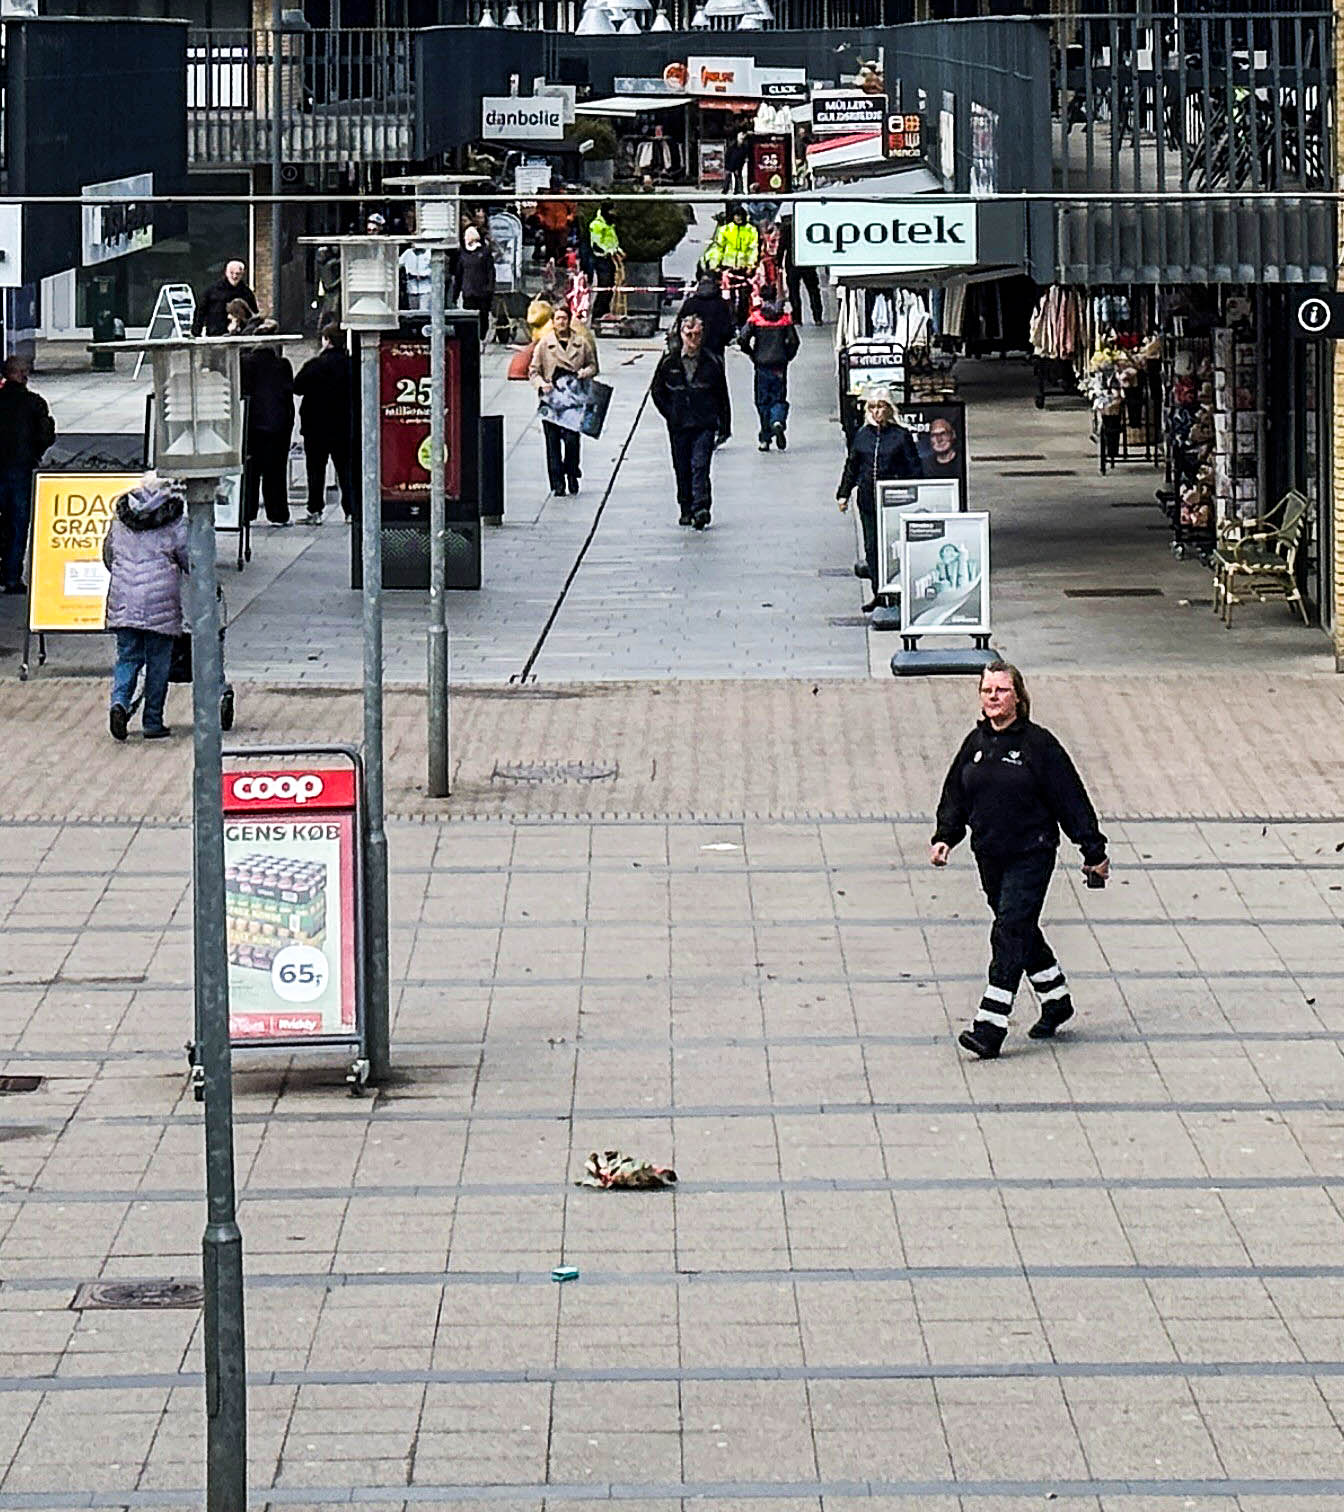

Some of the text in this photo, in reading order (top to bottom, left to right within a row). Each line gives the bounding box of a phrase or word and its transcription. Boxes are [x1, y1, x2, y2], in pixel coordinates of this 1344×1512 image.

[805, 215, 966, 254] apotek
[395, 377, 434, 407] 25
[232, 774, 324, 804] coop
[225, 824, 341, 842] GENS KØB
